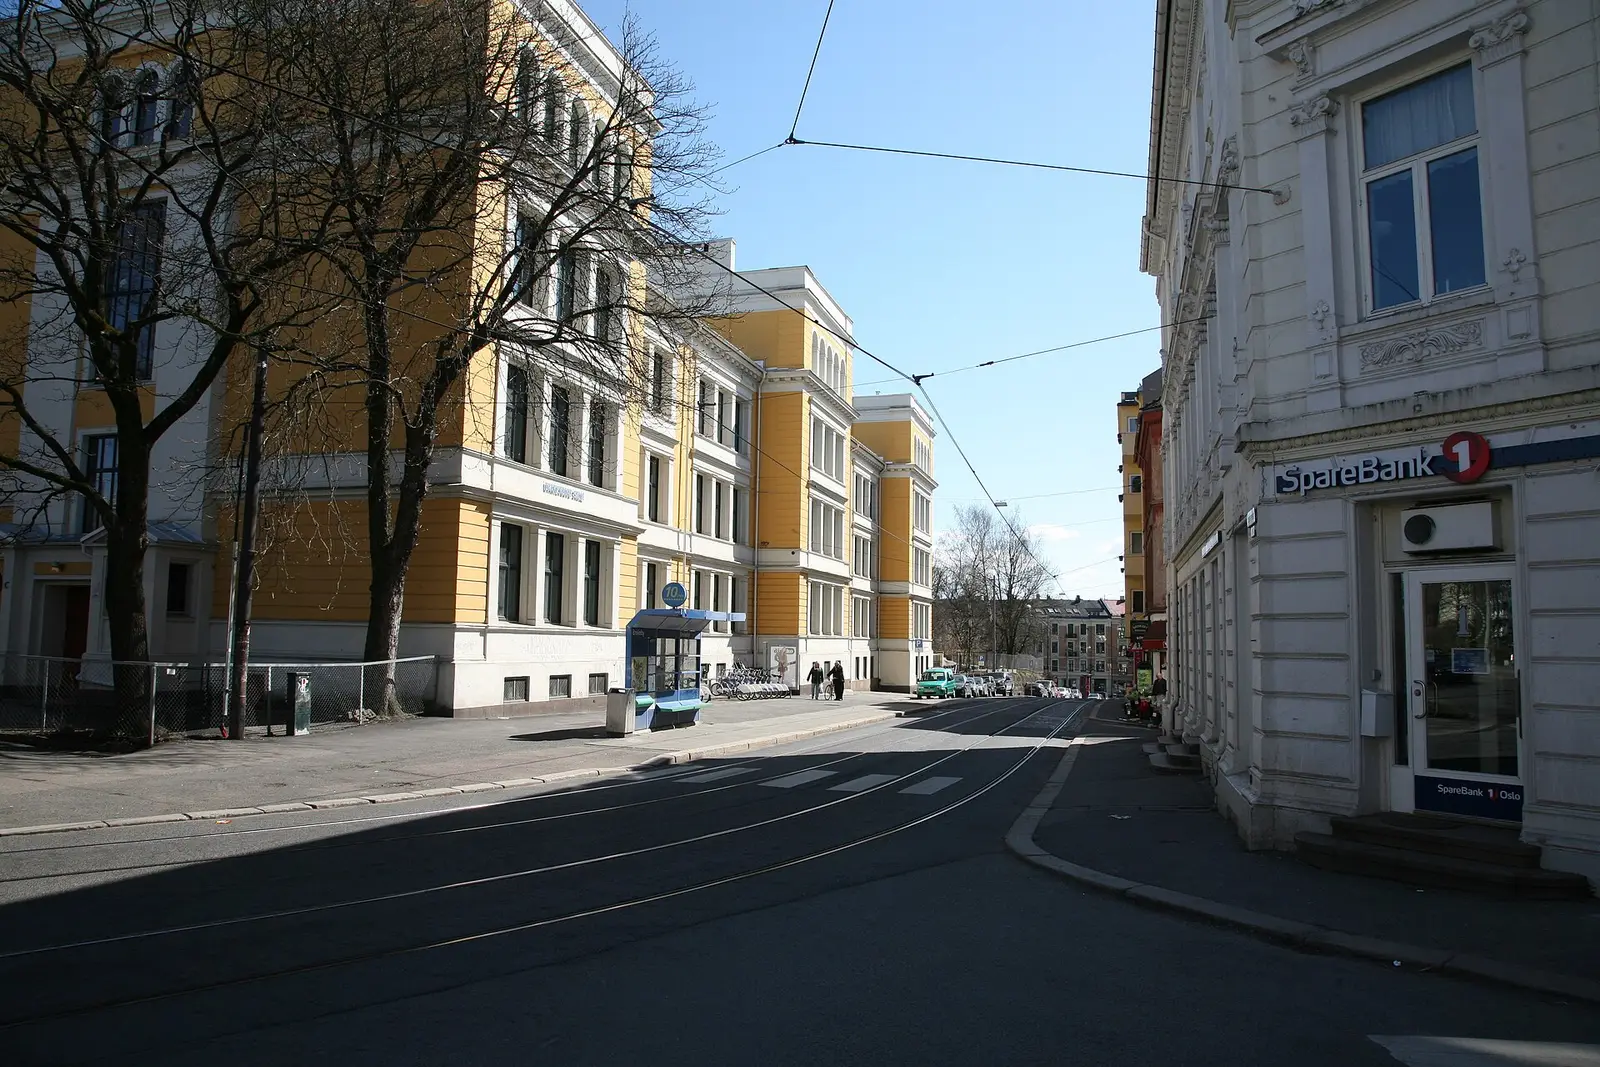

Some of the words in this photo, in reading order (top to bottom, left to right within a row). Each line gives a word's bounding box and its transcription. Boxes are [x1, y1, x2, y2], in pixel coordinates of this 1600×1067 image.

[1282, 454, 1434, 496] SpareBank
[1451, 440, 1471, 473] 1
[665, 586, 679, 598] 10
[1437, 784, 1484, 797] SpareBank
[1499, 790, 1521, 801] Oslo
